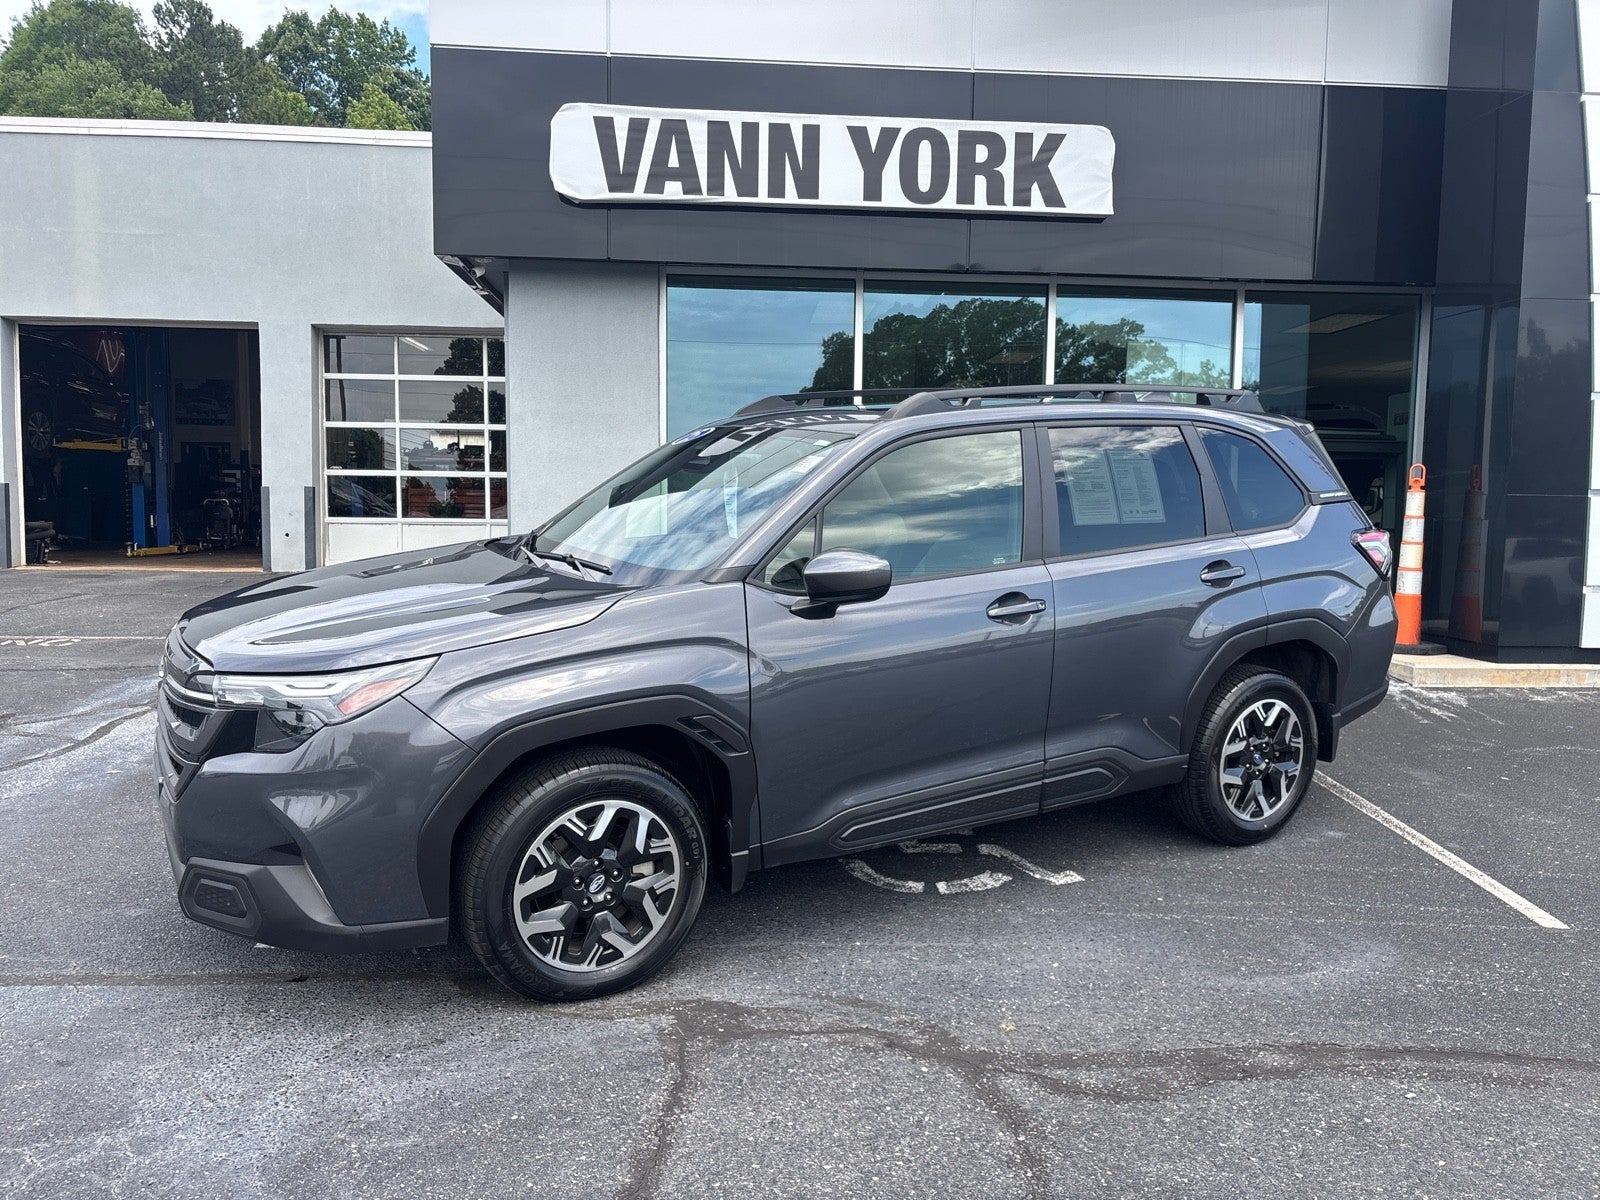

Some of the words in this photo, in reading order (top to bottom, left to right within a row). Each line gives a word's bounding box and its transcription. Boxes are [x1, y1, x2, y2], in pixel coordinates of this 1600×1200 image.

[592, 115, 820, 200] VANN
[846, 125, 1067, 208] YORK
[498, 941, 554, 993] OKOHAMA
